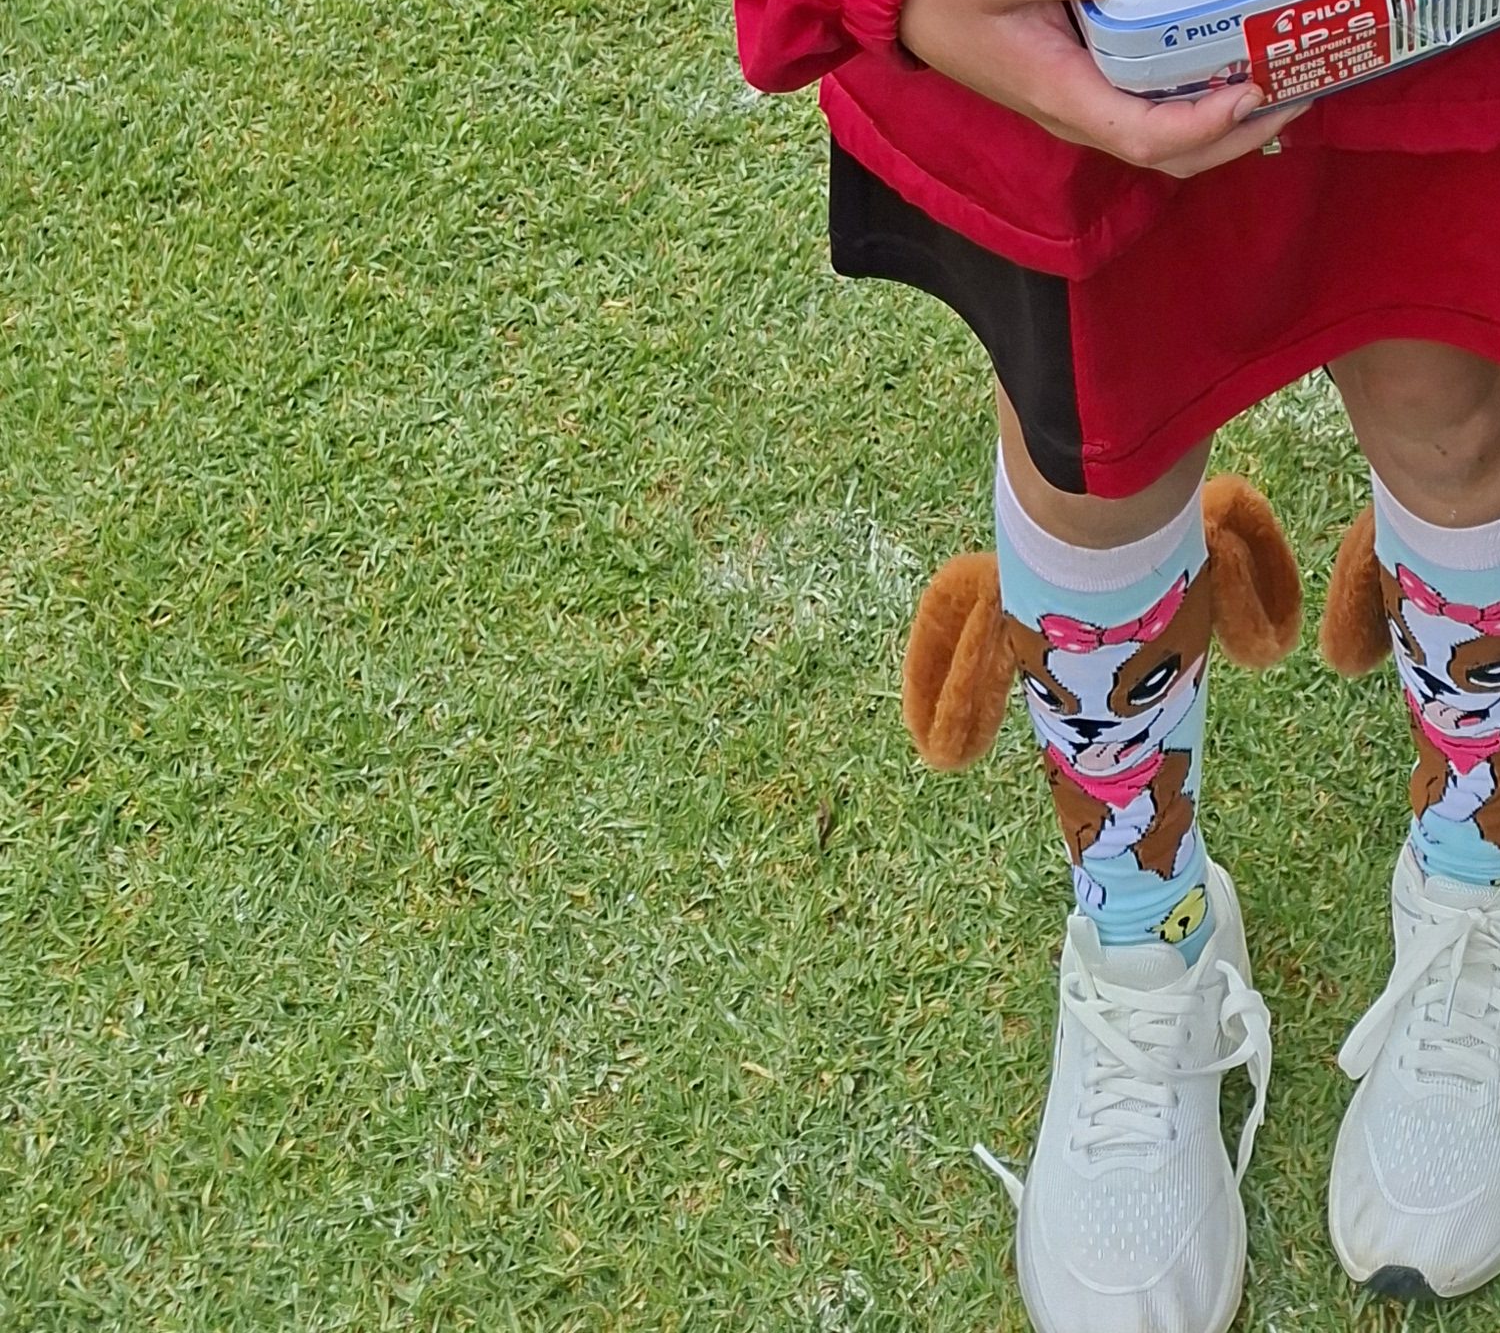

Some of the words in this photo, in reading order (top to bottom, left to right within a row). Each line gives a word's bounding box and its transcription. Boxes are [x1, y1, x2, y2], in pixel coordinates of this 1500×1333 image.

[1185, 14, 1242, 41] PILOT
[1266, 12, 1376, 59] BP-S
[1269, 56, 1291, 69] FINE
[1295, 36, 1352, 61] BALLPOINT
[1356, 28, 1376, 41] PEN
[1270, 70, 1286, 81] 12
[1291, 57, 1326, 74] PENS
[1277, 79, 1320, 99] GREEN
[1324, 76, 1334, 84] &
[1353, 55, 1385, 74] BLUE
